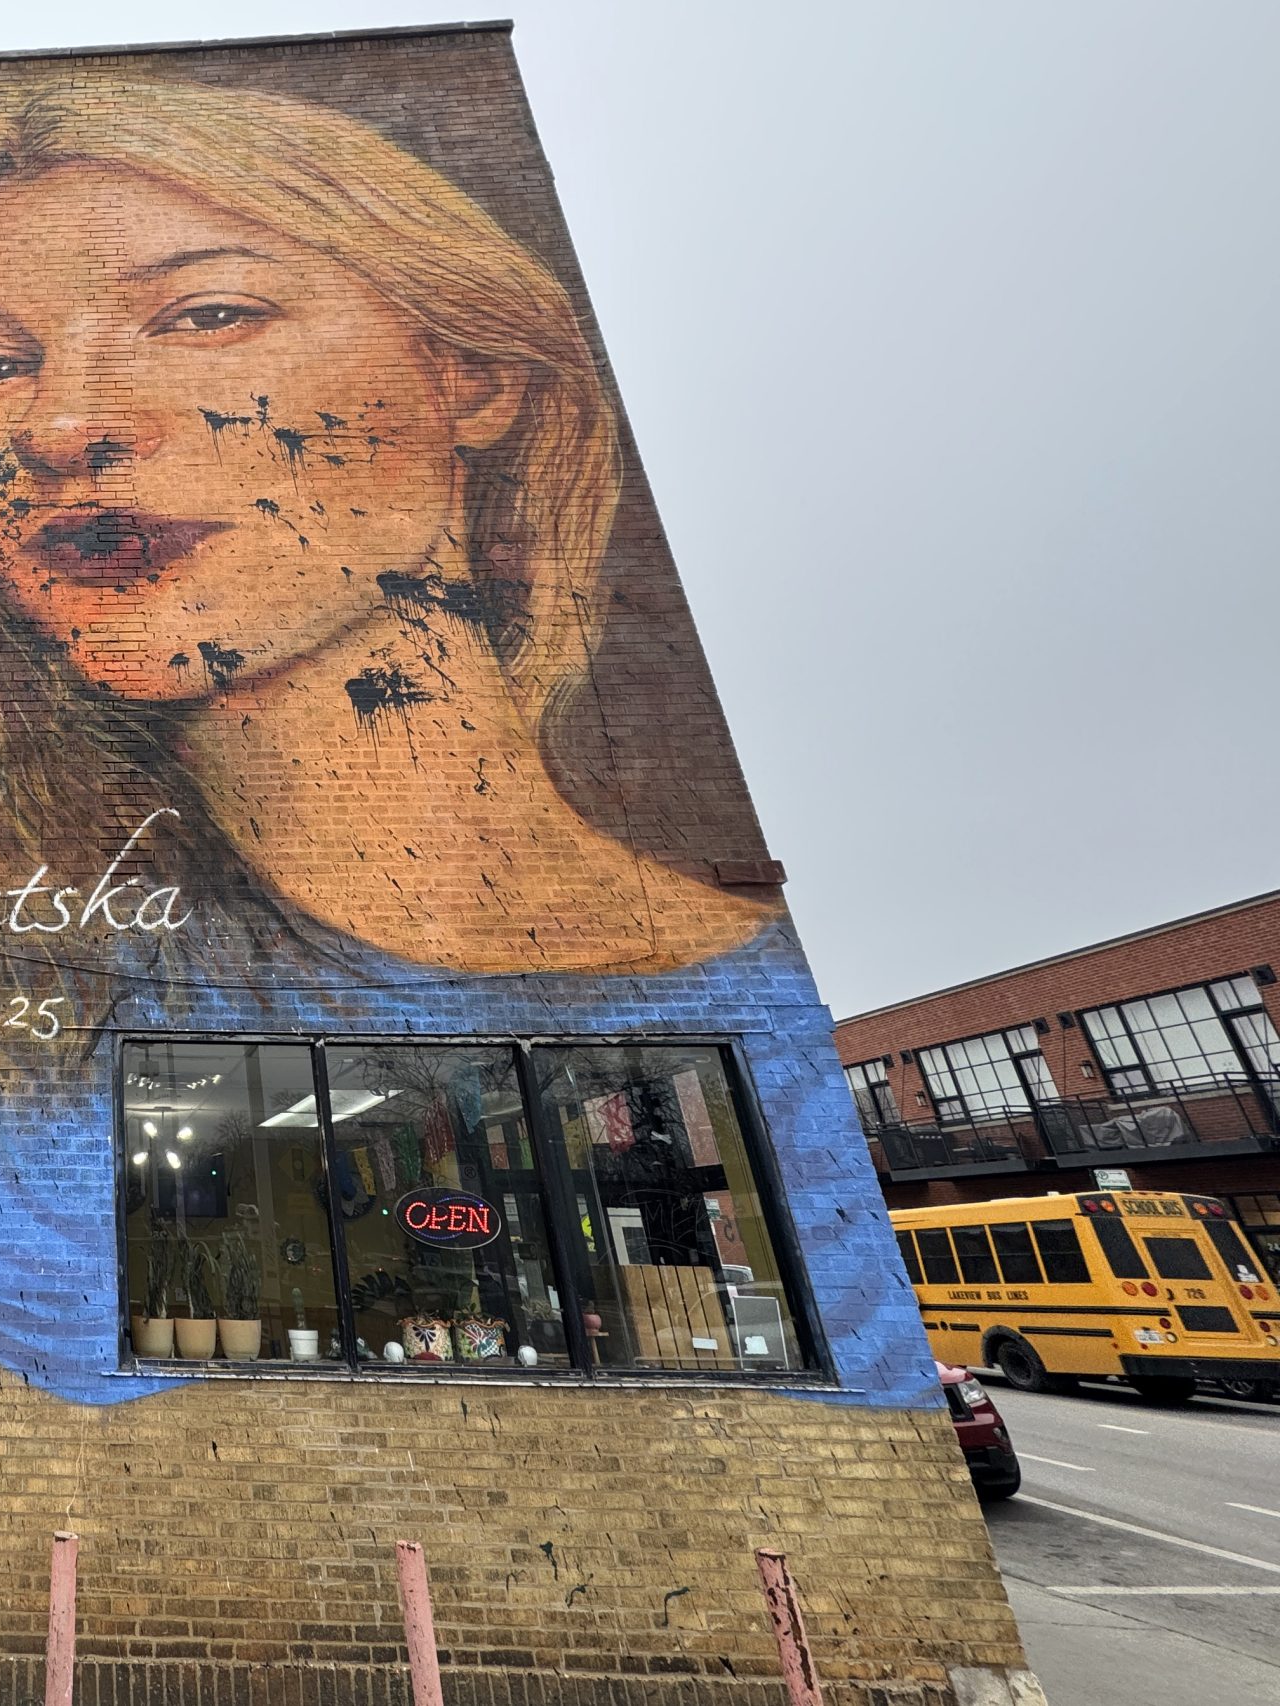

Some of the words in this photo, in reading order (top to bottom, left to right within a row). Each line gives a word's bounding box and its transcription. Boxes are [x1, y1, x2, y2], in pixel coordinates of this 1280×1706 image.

[1122, 1199, 1163, 1215] SCHOOL
[1160, 1200, 1184, 1216] BUS
[405, 1202, 490, 1234] OPEN
[947, 1290, 982, 1300] LAKEVIEW
[986, 1290, 1002, 1300] BUS
[1006, 1290, 1029, 1300] LINES
